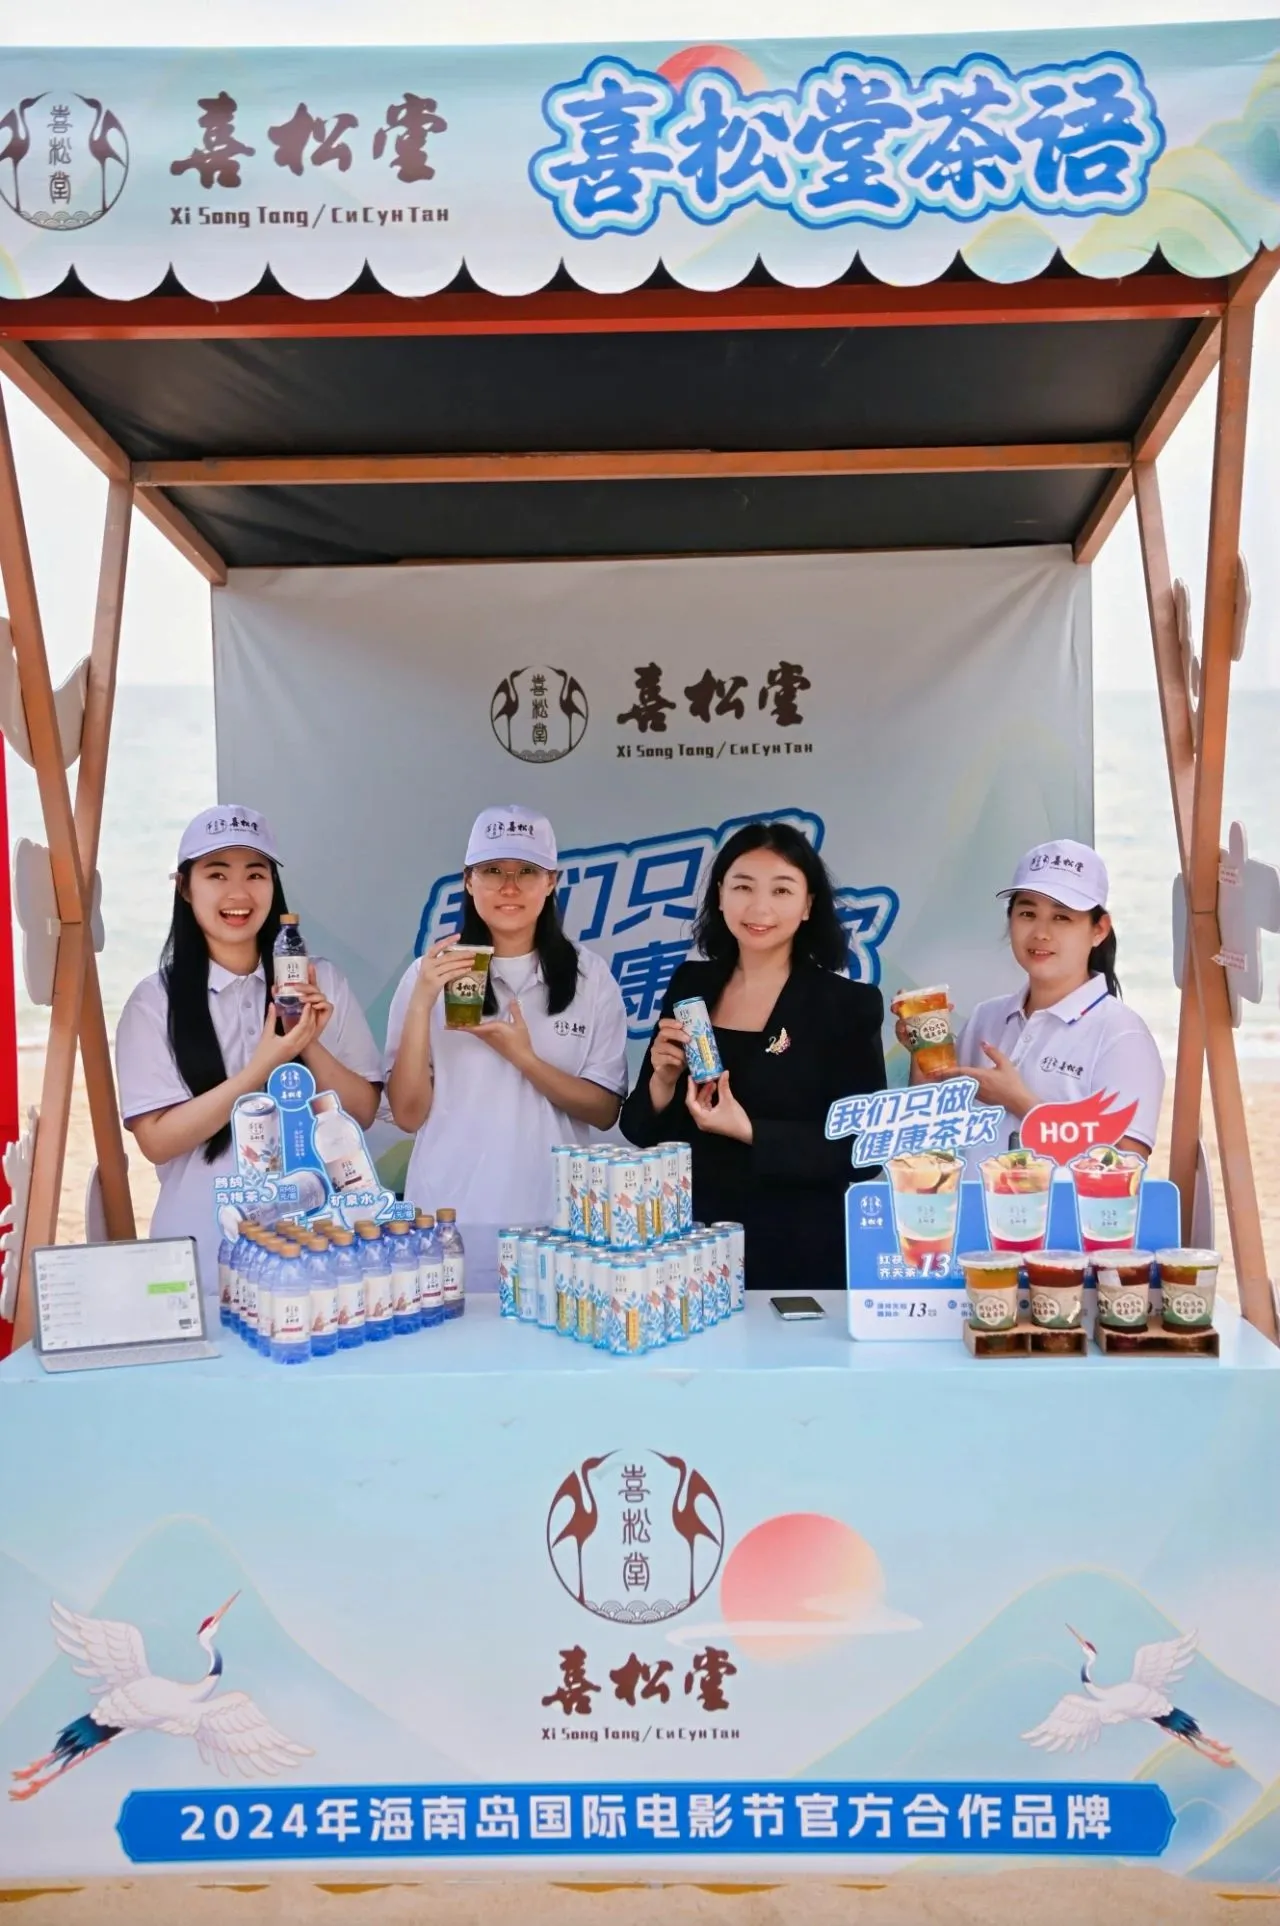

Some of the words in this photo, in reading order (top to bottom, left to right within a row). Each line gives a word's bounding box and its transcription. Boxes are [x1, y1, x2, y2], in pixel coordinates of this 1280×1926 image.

[170, 91, 447, 189] 喜松堂
[550, 72, 1147, 217] 喜松堂茶语
[171, 207, 191, 225] Xi
[198, 207, 250, 228] Song
[617, 661, 812, 733] 喜松堂
[616, 745, 631, 758] Xi
[636, 744, 673, 759] Song
[831, 1082, 975, 1134] 我们只做
[858, 1111, 1000, 1161] 健康茶饮
[1040, 1121, 1100, 1144] HOT
[260, 1173, 280, 1202] 5
[330, 1193, 374, 1208] 矿泉水
[375, 1191, 396, 1220] 2
[920, 1252, 951, 1278] 13
[908, 1302, 928, 1317] 13
[541, 1645, 737, 1715] 喜松堂
[541, 1728, 556, 1740] Xi
[561, 1727, 598, 1742] Song
[181, 1794, 1112, 1843] 2024年海南岛国际电影节官方合作品牌
